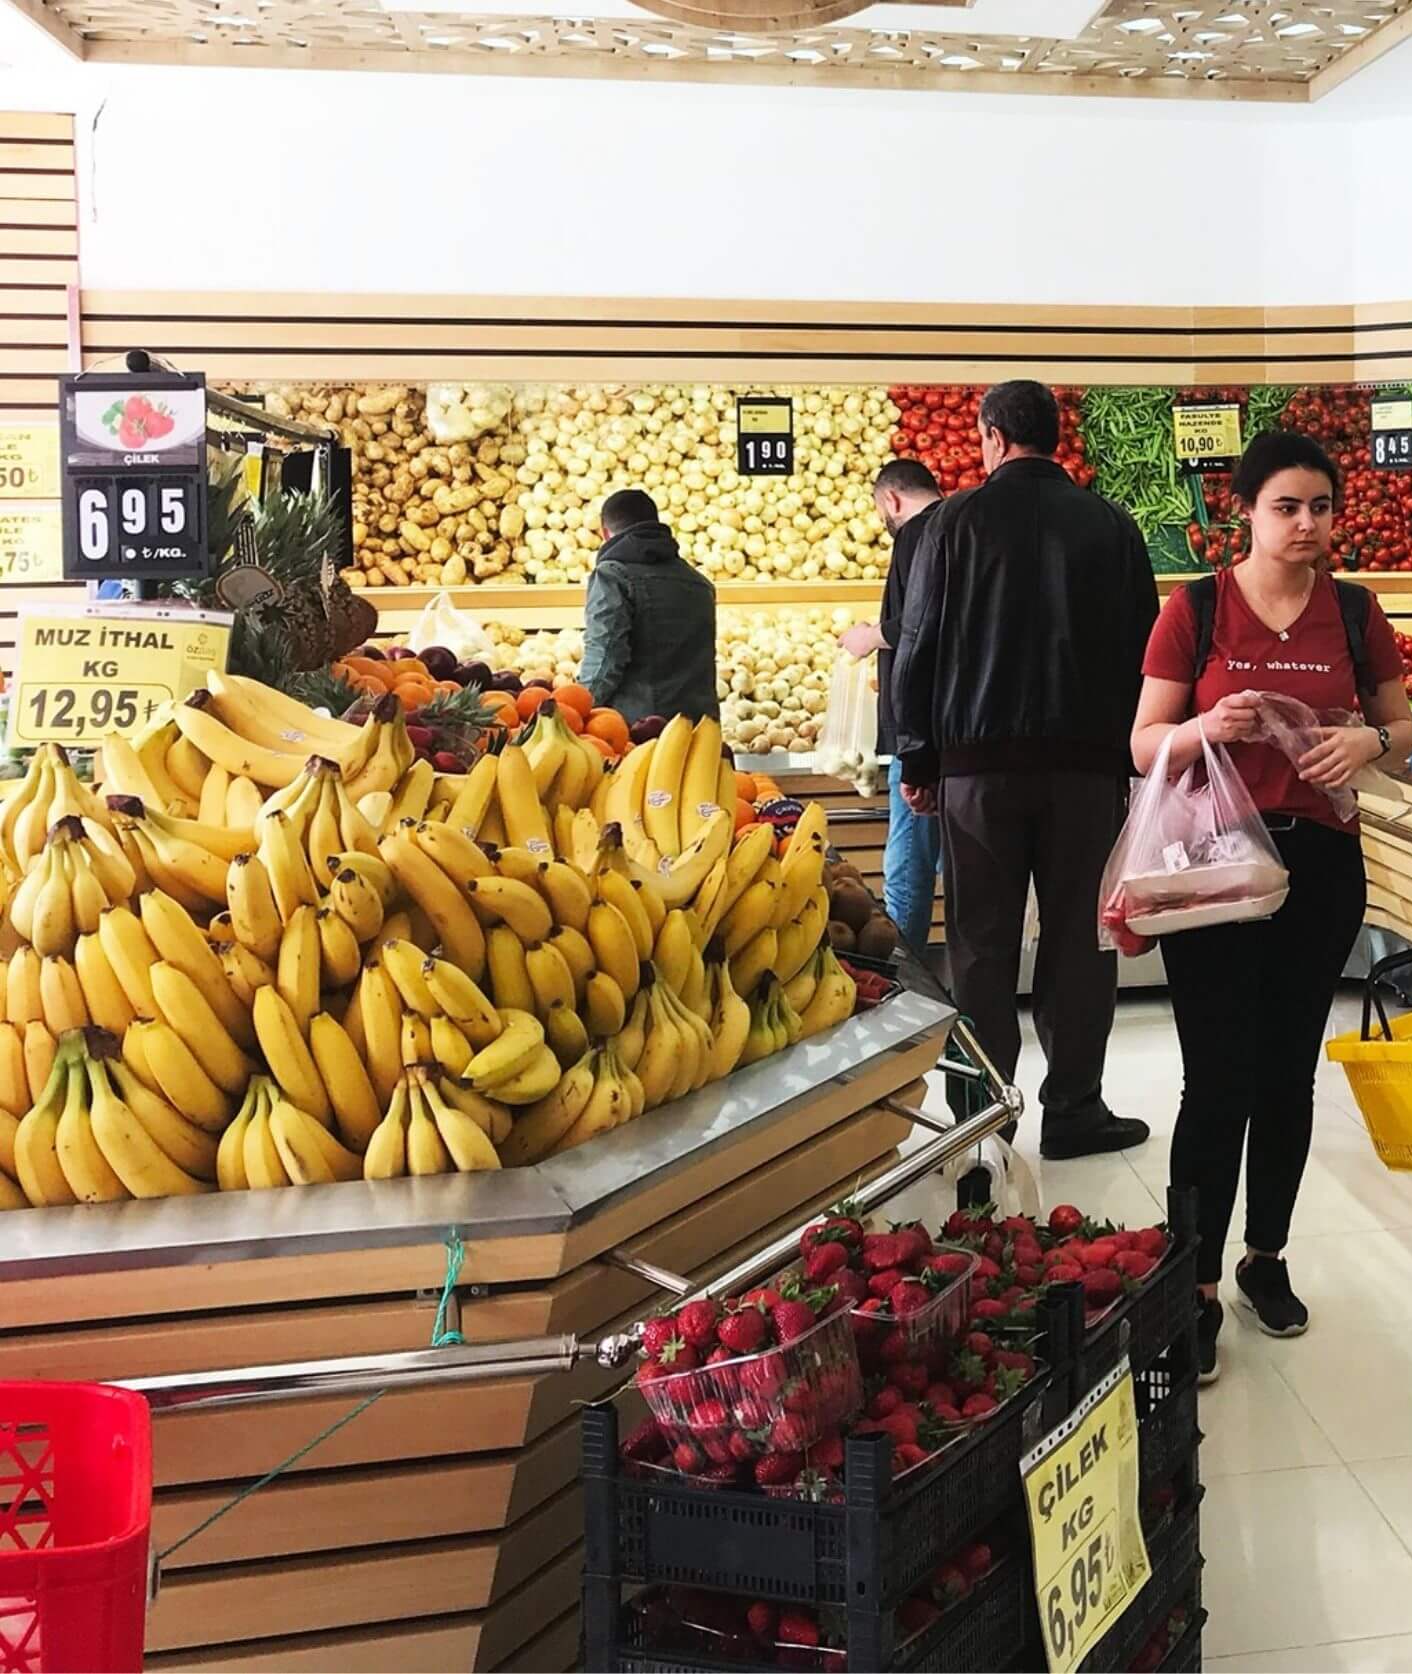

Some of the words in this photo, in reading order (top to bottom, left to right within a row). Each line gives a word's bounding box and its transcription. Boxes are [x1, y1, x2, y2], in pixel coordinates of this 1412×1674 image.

[124, 453, 161, 467] ÇİLEK
[34, 628, 91, 647] MUZ
[99, 626, 174, 650] İTHAL
[82, 660, 119, 678] KG
[1227, 660, 1257, 671] yes,
[1266, 661, 1332, 673] whatever
[29, 688, 139, 737] 12,95
[1037, 1423, 1110, 1525] ÇİLEK
[1060, 1496, 1095, 1553] KG
[1047, 1533, 1102, 1659] 6,95
